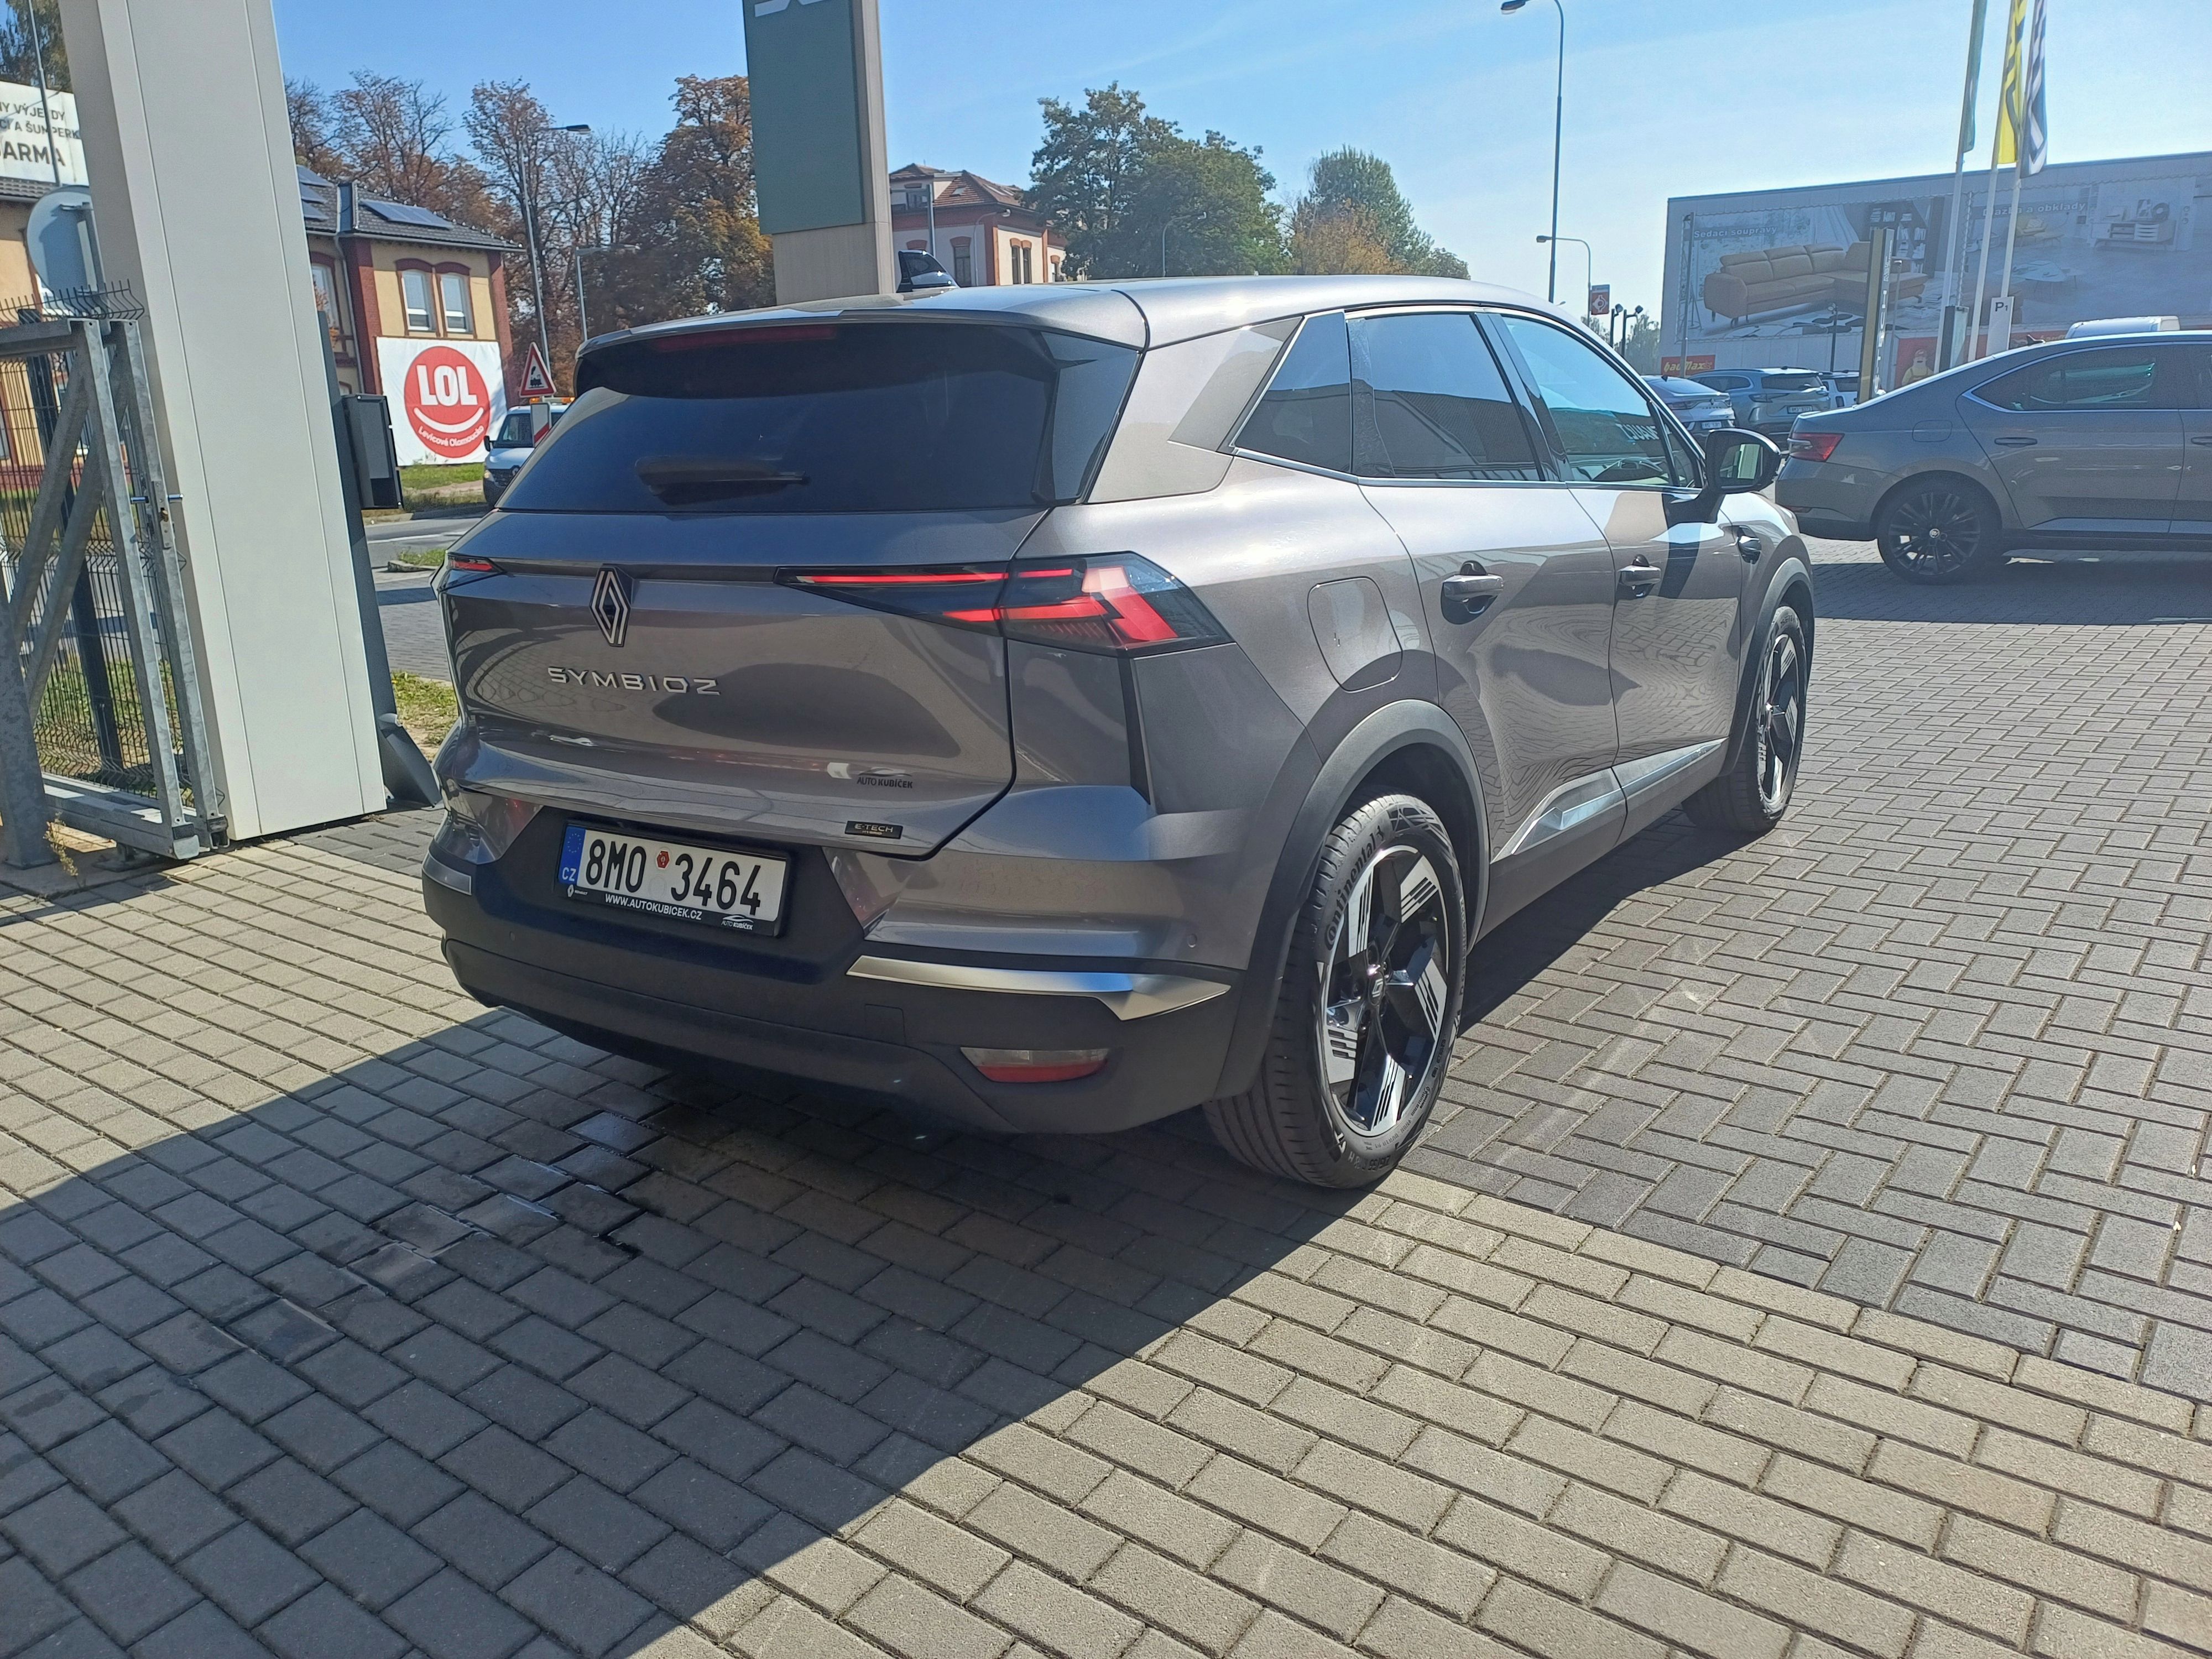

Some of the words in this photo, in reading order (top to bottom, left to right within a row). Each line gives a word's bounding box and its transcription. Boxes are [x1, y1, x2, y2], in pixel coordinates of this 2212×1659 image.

[14, 103, 65, 121] VÝJEDY
[15, 121, 23, 131] A
[0, 141, 66, 166] ARMA
[2037, 202, 2086, 212] obklady
[1731, 227, 1777, 236] soupravy
[416, 364, 478, 406] LOL
[547, 666, 721, 696] SYMBIOZ
[857, 777, 877, 786] AUTO
[878, 779, 913, 789] KUBÍČEK
[562, 867, 577, 882] CZ
[671, 853, 761, 916] 3464
[1324, 833, 1376, 951] Continental
[605, 893, 702, 921] WWW.AUTOKUBICEK.CZ
[733, 922, 753, 930] KUBÍČEK
